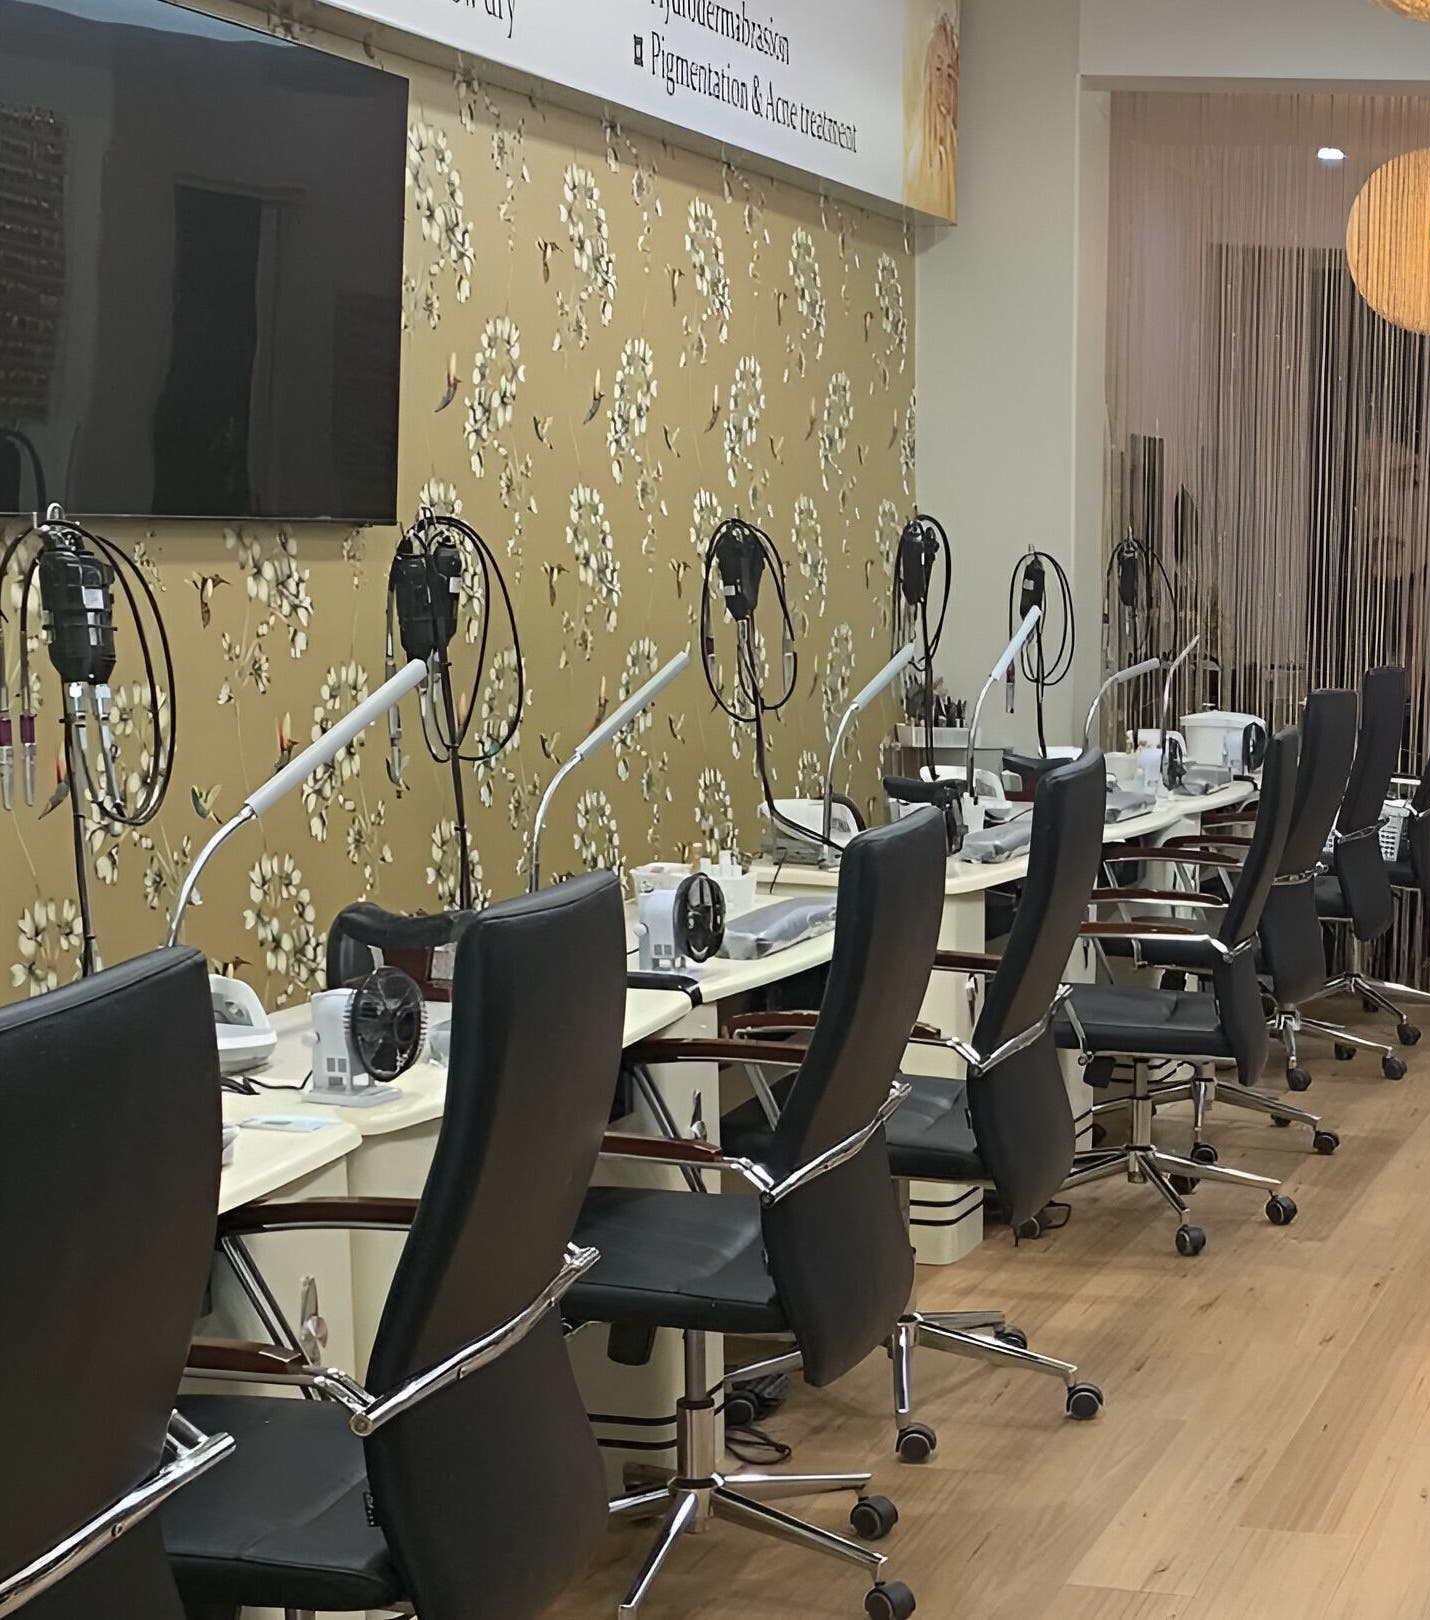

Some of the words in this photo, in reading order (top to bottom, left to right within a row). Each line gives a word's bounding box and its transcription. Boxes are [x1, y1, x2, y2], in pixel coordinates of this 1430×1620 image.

[651, 31, 749, 96] Pigmentation
[751, 74, 763, 118] &
[765, 81, 798, 131] Acne
[800, 103, 857, 153] treatment
